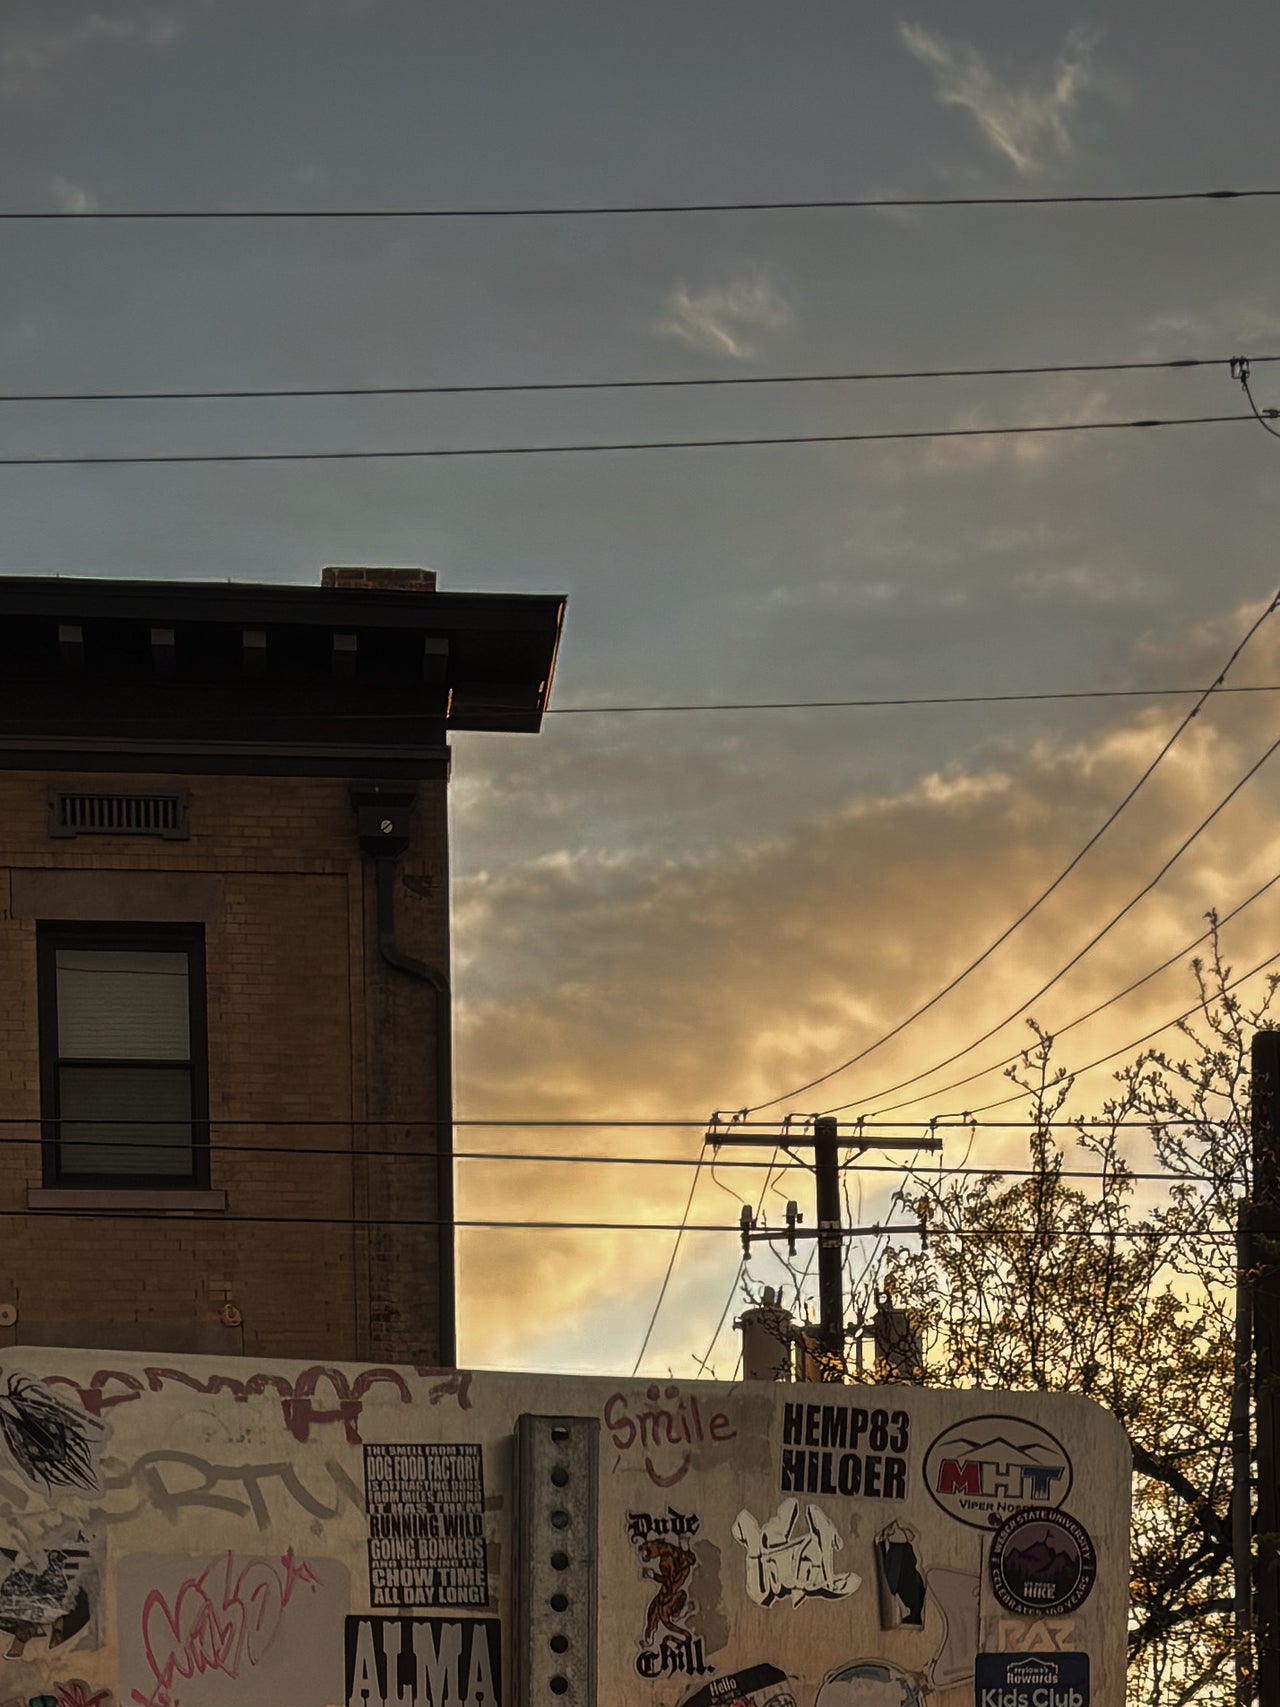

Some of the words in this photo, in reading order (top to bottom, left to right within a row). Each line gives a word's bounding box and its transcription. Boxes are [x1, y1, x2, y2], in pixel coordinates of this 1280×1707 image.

[367, 1456, 392, 1480] DOG
[395, 1456, 425, 1480] FOOD
[427, 1456, 480, 1480] FACTORY
[381, 1480, 449, 1491] ATTRACTING
[937, 1459, 1065, 1500] MHT
[402, 1491, 434, 1503] MILES
[437, 1491, 482, 1503] AROUND
[959, 1499, 994, 1512] VIPER
[370, 1514, 439, 1538] RUNNING
[444, 1514, 483, 1538] WILD
[629, 1507, 700, 1543] Dude
[995, 1522, 1017, 1554] WEBER
[1018, 1509, 1048, 1526] STATE
[1048, 1510, 1092, 1560] UNIVERSITY
[371, 1539, 415, 1559] GOING
[419, 1539, 484, 1559] BONKERS
[372, 1568, 434, 1587] CHOW
[438, 1568, 485, 1587] TIME
[374, 1588, 400, 1604] ALL
[403, 1588, 434, 1604] DAY
[438, 1587, 486, 1604] LONG!
[1023, 1587, 1056, 1600] HIKE
[1064, 1576, 1089, 1610] YEARS
[636, 1636, 715, 1679] Chill.
[709, 1676, 737, 1697] Hello
[1032, 1687, 1083, 1707] Club
